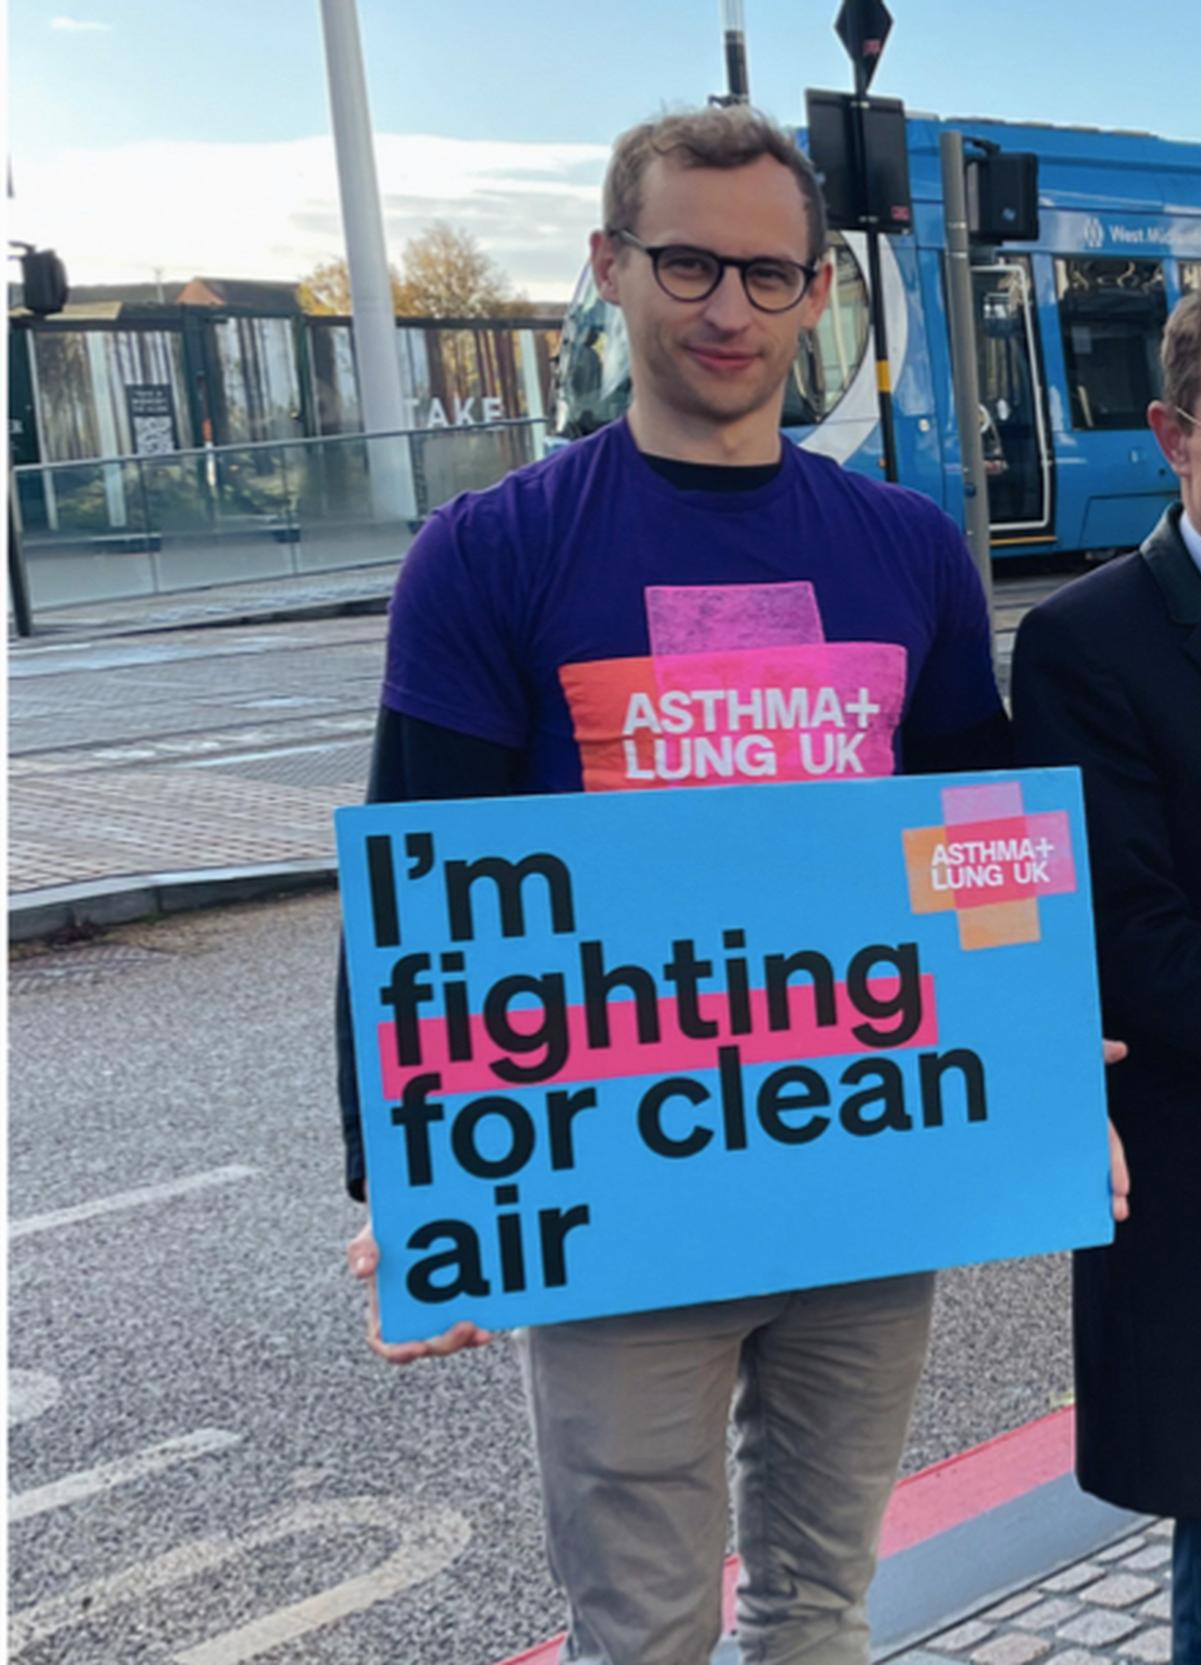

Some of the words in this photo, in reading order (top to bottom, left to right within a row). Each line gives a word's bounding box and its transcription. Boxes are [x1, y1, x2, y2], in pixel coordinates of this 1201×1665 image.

[1109, 223, 1144, 243] West
[404, 396, 504, 430] TAKE
[622, 687, 880, 736] ASTHMA+
[624, 734, 777, 780] LUNG
[799, 732, 865, 775] UK
[931, 837, 1055, 868] ASTHMA+
[931, 864, 1004, 891] LUNG
[1013, 860, 1050, 885] UK
[379, 928, 924, 1084] fighting
[391, 1072, 598, 1188] for
[636, 1044, 990, 1160] clean
[404, 1184, 591, 1304] air
